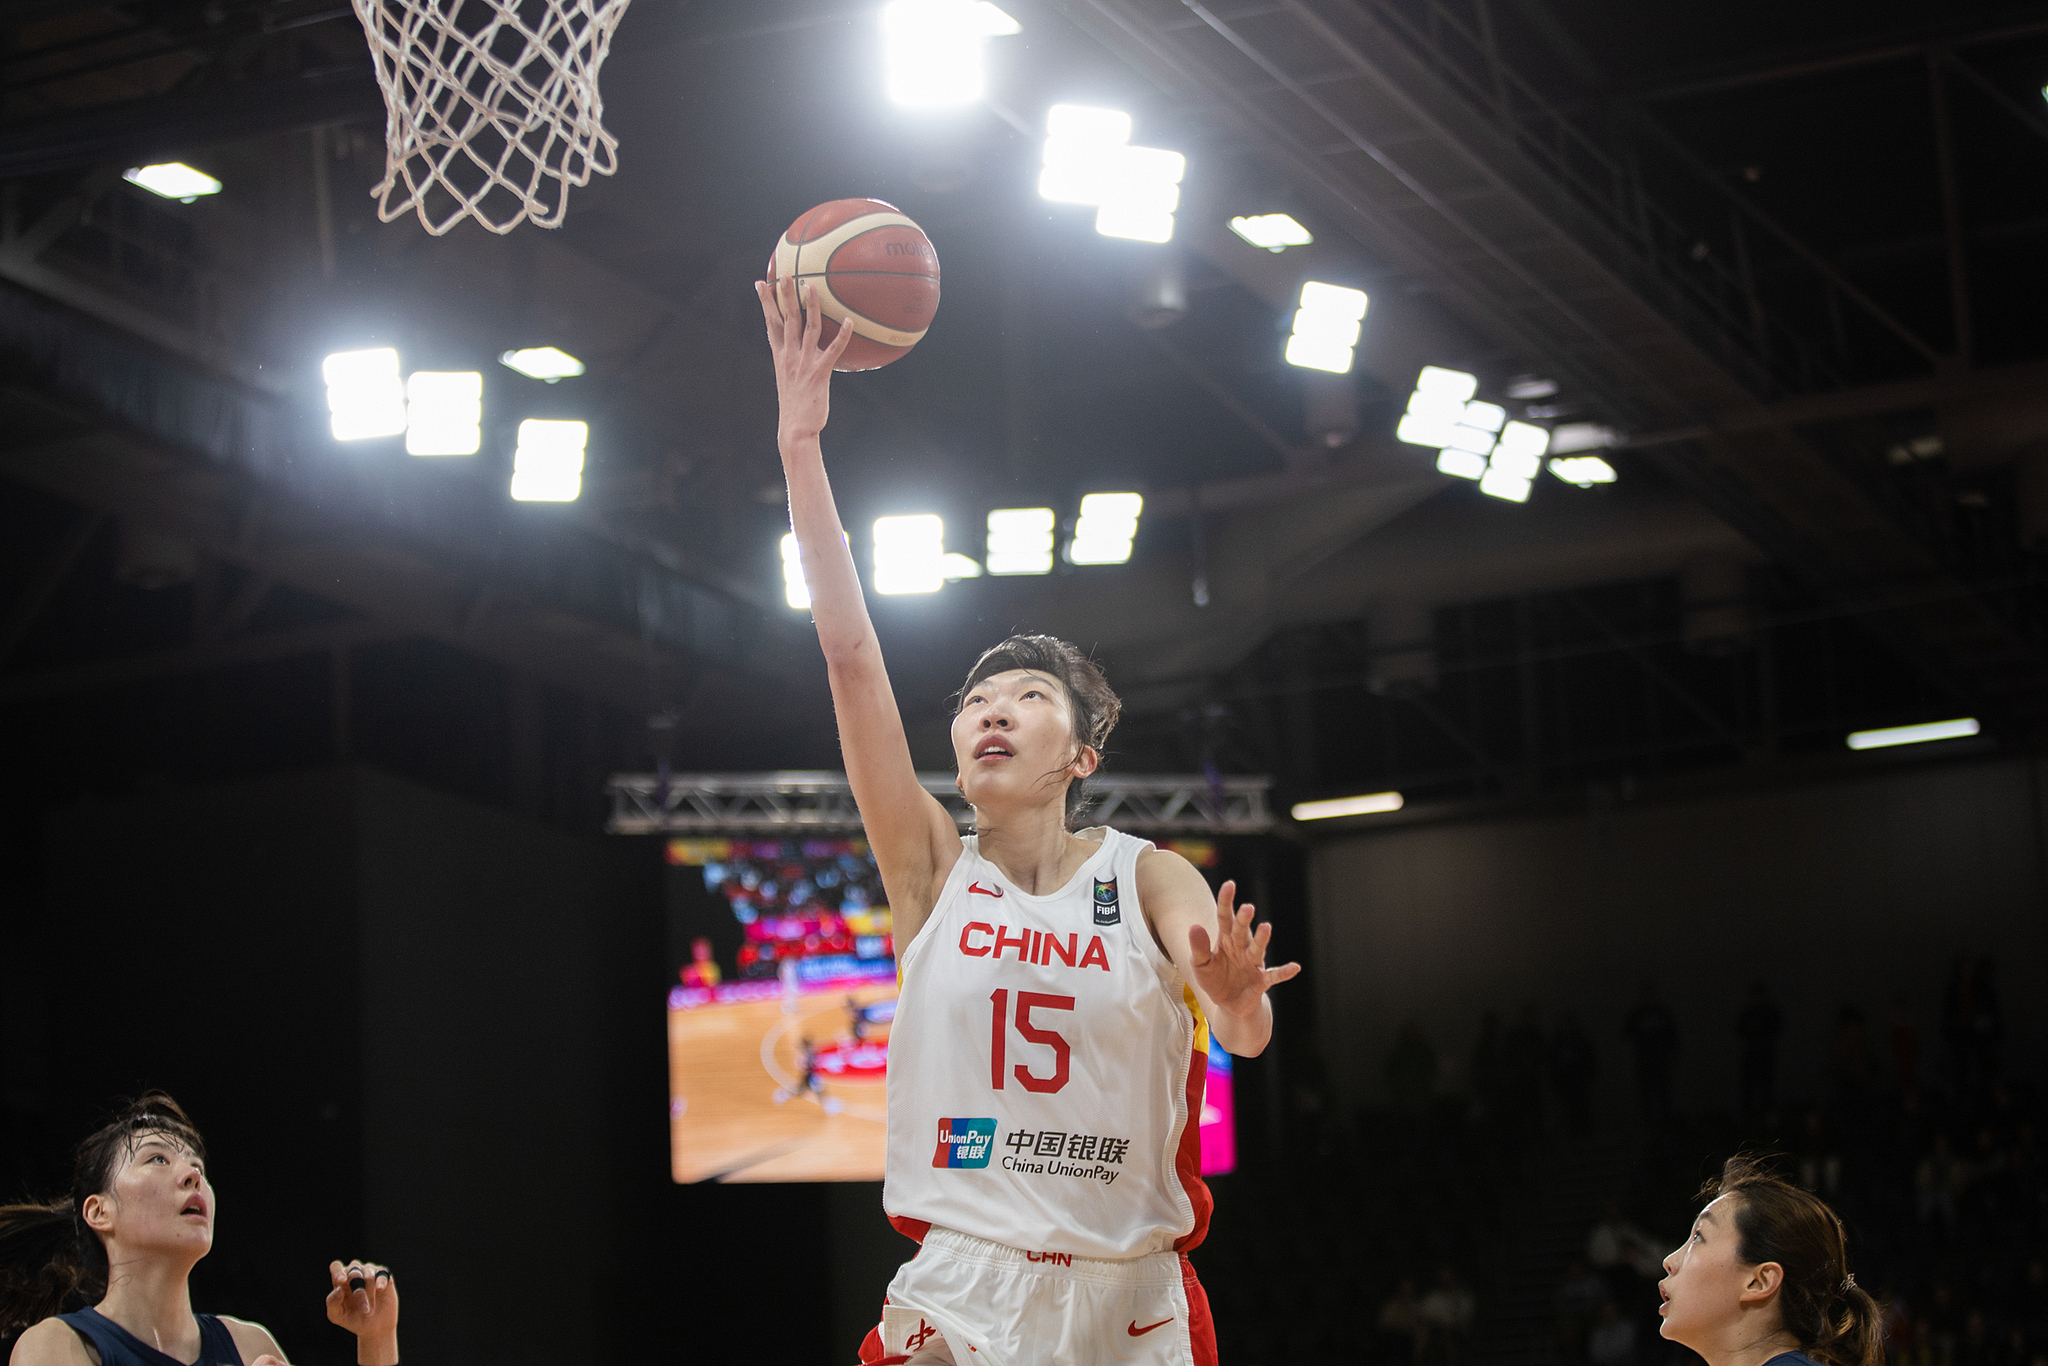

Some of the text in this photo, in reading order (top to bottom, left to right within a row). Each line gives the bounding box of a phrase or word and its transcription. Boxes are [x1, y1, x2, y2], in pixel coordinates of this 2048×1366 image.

[1096, 905, 1116, 916] FIBA
[959, 921, 1111, 972] CHINA
[989, 988, 1076, 1094] 15
[940, 1130, 991, 1149] UnionPay
[1005, 1129, 1130, 1164] 中国银联
[957, 1146, 986, 1159] 银联
[1002, 1156, 1119, 1185] China UnionPay
[1027, 1250, 1072, 1268] CHN
